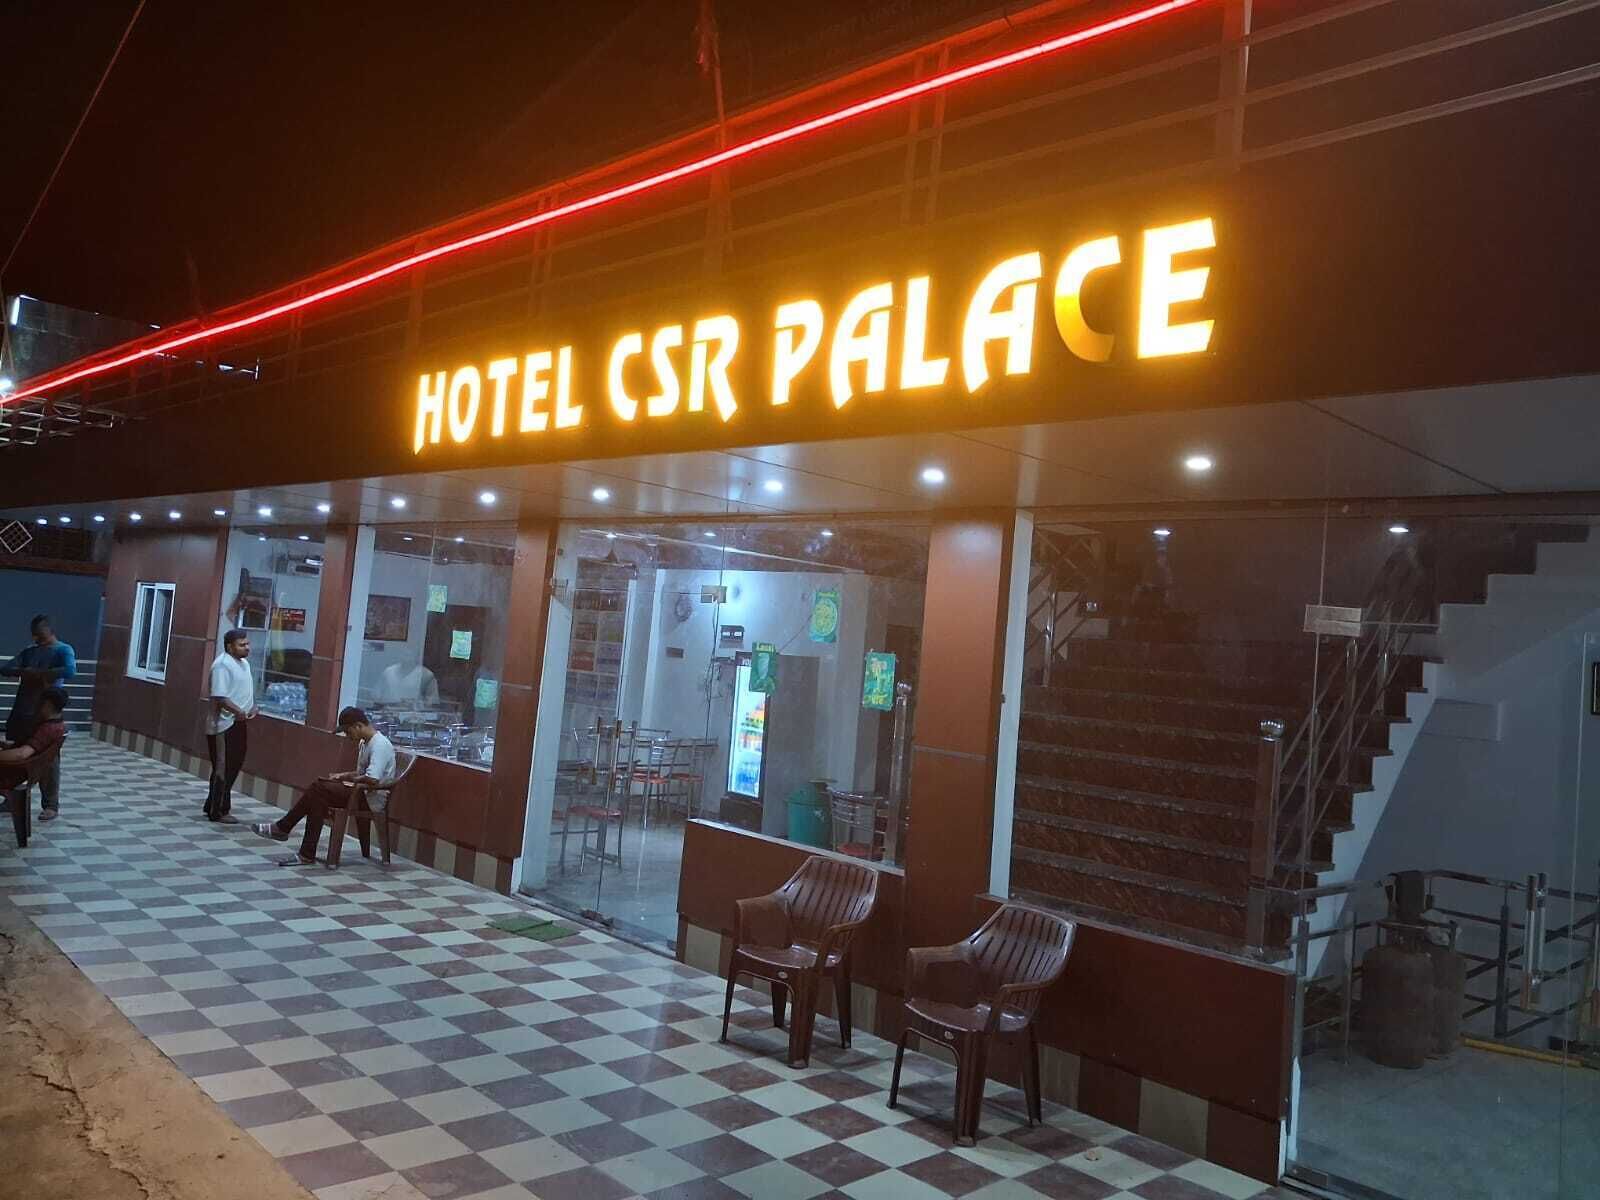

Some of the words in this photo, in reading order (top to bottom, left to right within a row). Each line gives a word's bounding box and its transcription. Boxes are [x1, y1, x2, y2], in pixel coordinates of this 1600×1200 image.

[413, 344, 584, 455] HOTEL
[607, 314, 741, 423] CSR
[772, 216, 1216, 411] PALACE
